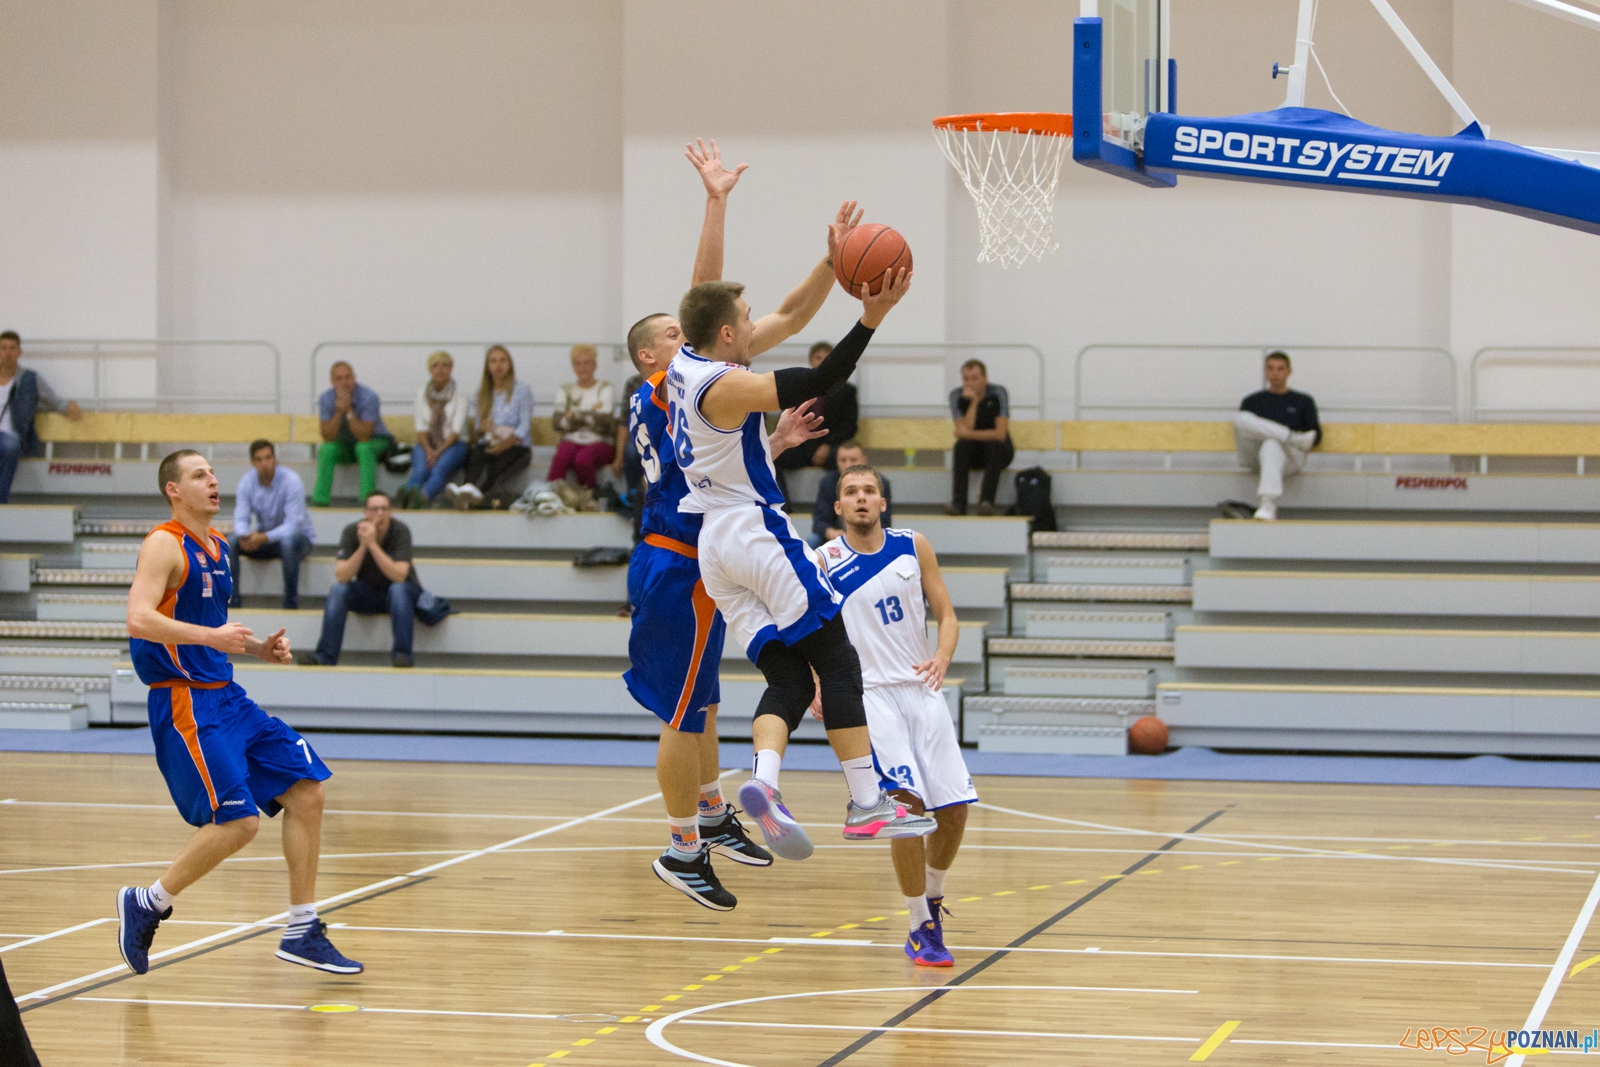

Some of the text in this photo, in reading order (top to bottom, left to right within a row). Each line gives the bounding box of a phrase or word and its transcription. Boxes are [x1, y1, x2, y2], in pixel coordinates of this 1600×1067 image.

[1174, 126, 1454, 178] SPORTSYSTEM
[874, 595, 904, 625] 13
[887, 764, 914, 788] 13
